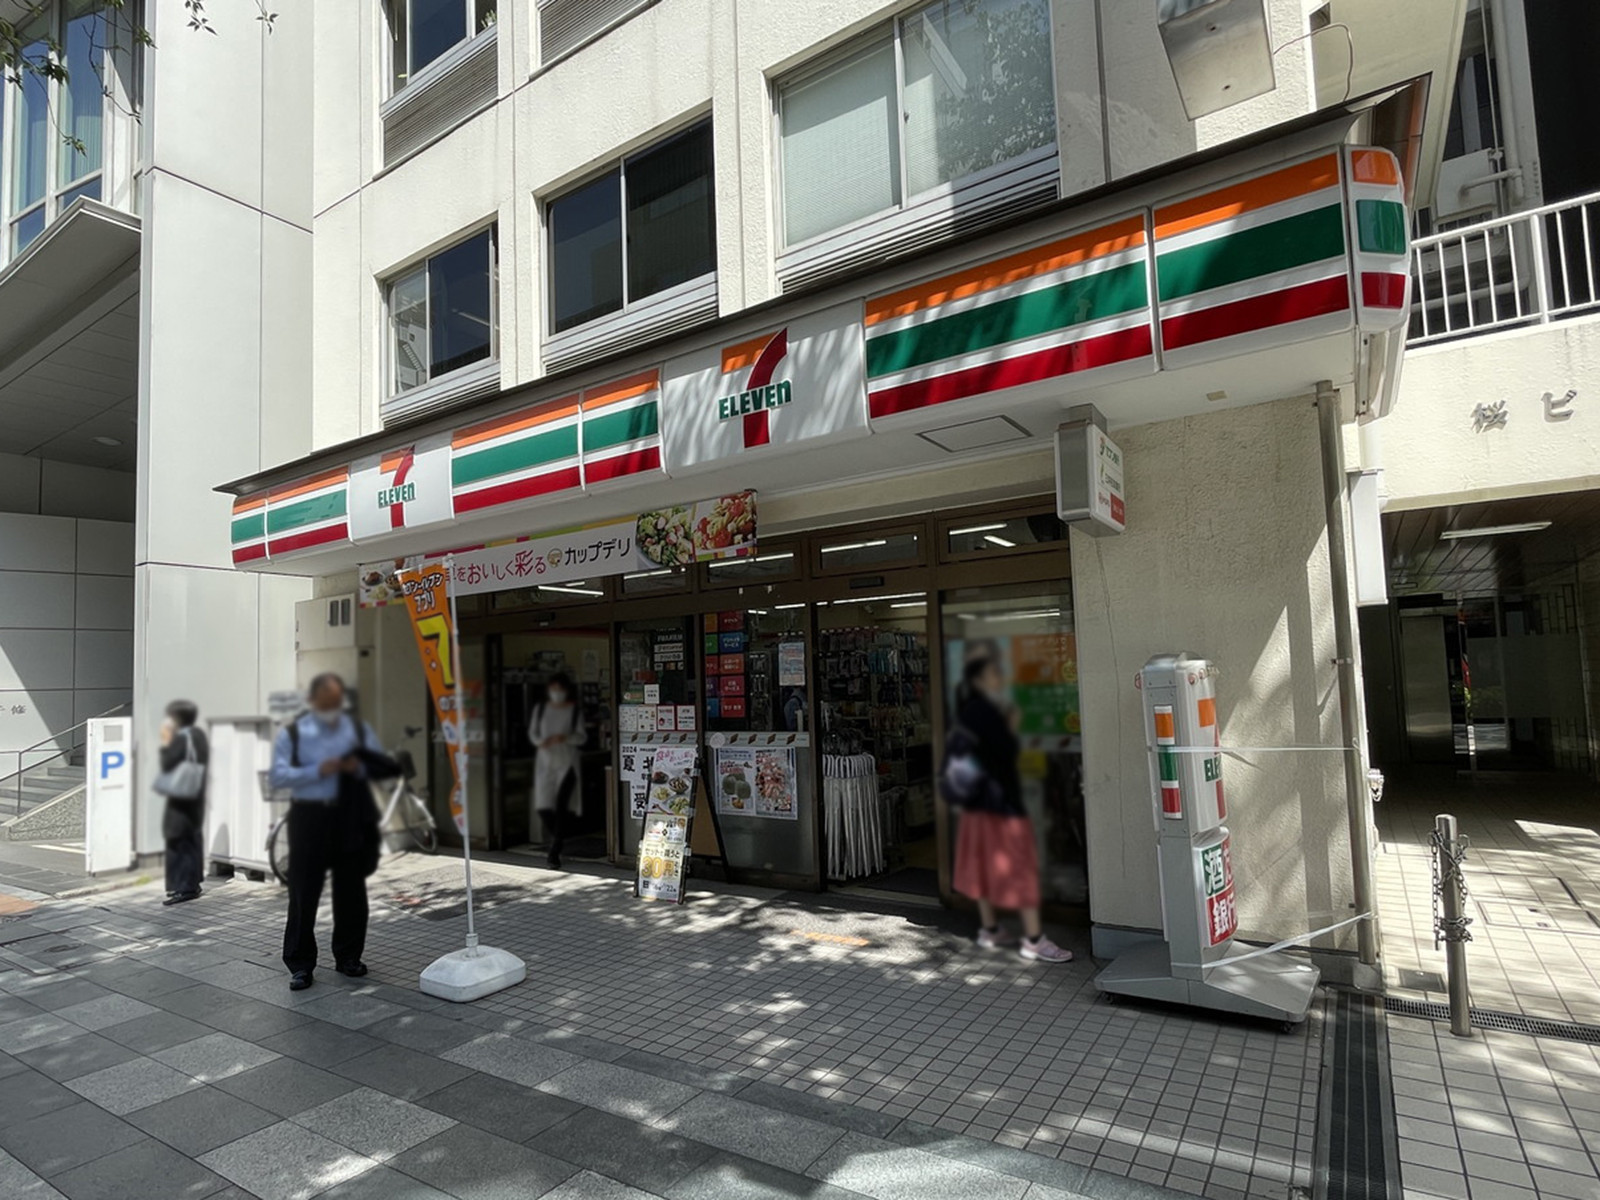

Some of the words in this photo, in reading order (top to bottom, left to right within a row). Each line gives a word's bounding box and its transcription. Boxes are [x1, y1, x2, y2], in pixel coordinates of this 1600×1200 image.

[565, 538, 631, 566] カップデリ
[101, 751, 125, 779] P
[1205, 849, 1224, 896] 酒
